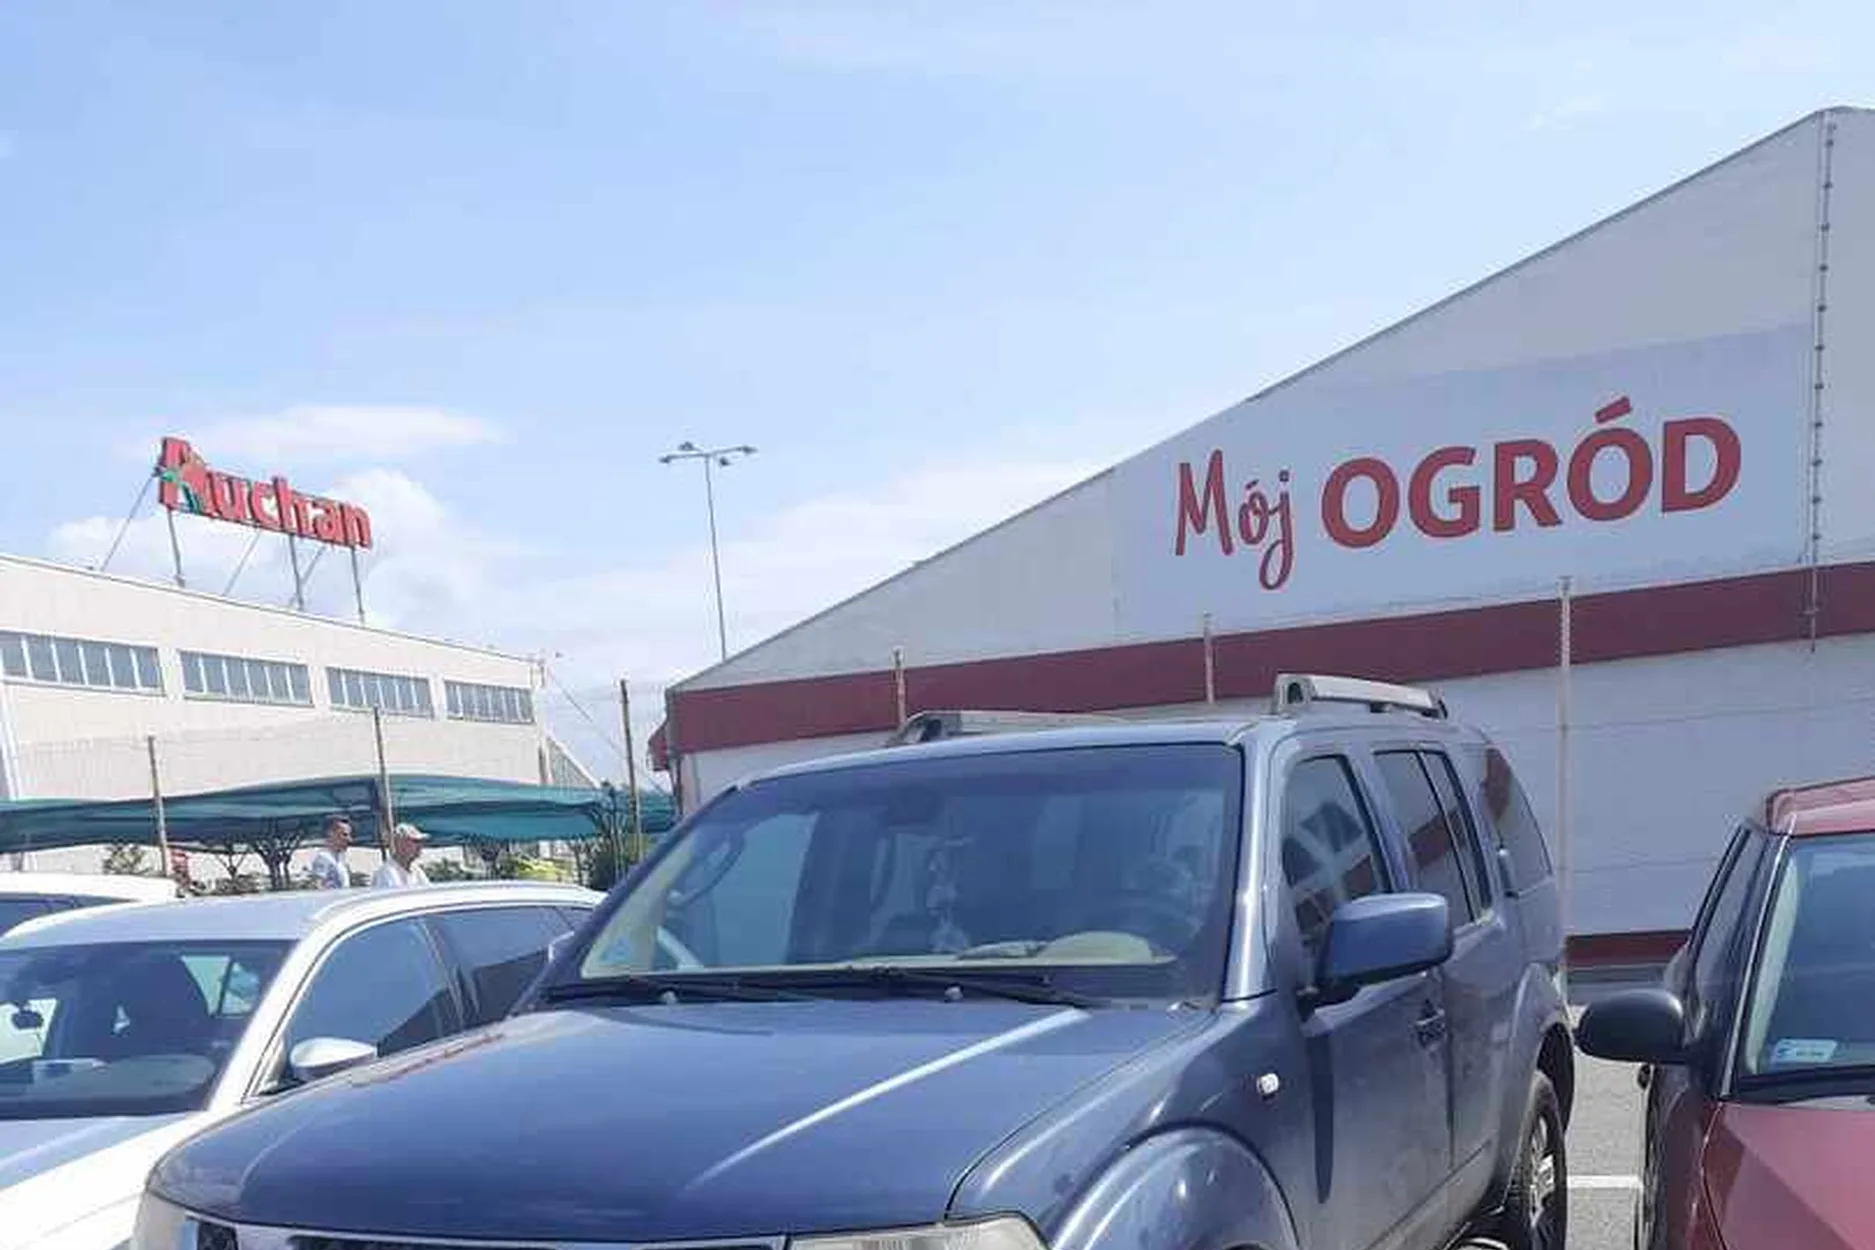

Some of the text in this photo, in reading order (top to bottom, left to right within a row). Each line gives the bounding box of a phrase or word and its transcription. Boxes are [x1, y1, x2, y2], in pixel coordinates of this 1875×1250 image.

[157, 437, 372, 548] Auchan
[1175, 396, 1742, 591] Mój OGRÓD
